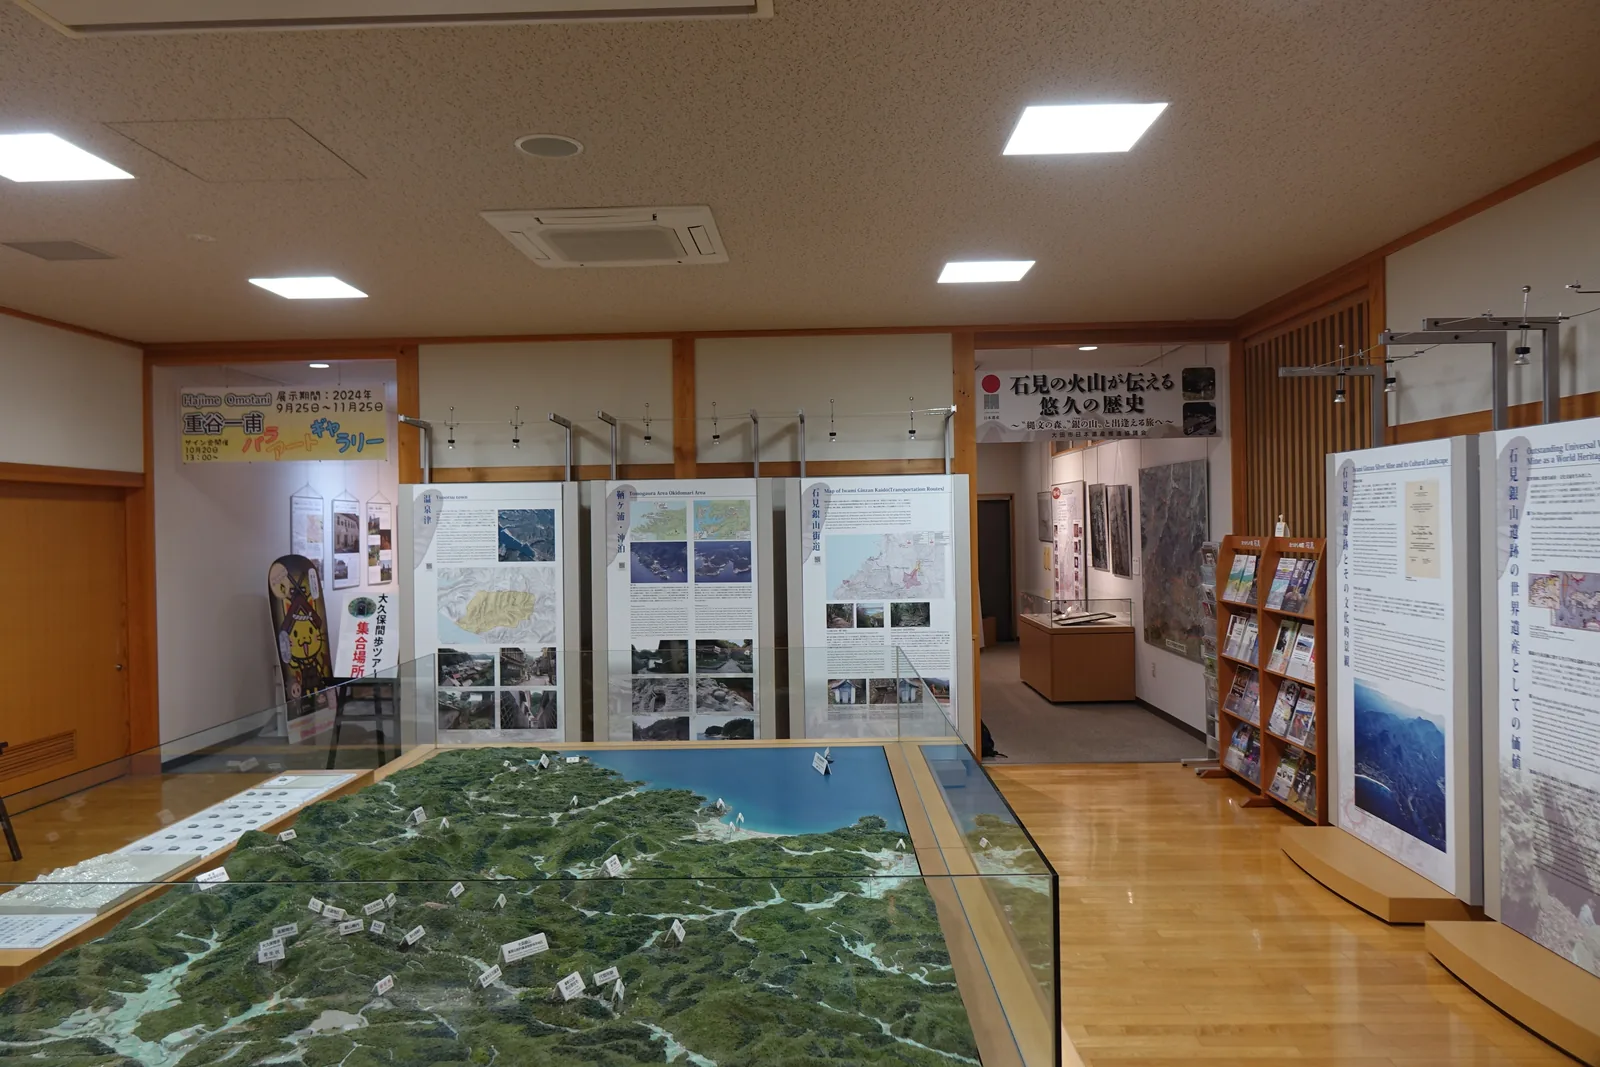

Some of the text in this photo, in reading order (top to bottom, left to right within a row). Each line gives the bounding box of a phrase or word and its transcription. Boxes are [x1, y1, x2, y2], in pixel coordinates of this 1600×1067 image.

[1010, 372, 1175, 396] 石見の火山が伝える
[182, 393, 273, 408] Hajime Omotani
[1039, 394, 1145, 417] 悠久の歴史
[183, 412, 264, 435] 重谷一甫
[186, 446, 218, 454] 10月20日
[1526, 444, 1563, 454] Outstanding
[1564, 440, 1596, 451] Universal
[1409, 459, 1425, 467] Cultural
[1426, 457, 1449, 465] Landscape
[1527, 457, 1542, 465] Mine
[1556, 453, 1576, 462] World
[812, 488, 821, 551] 石見銀山街道
[349, 621, 370, 679] 集合場所
